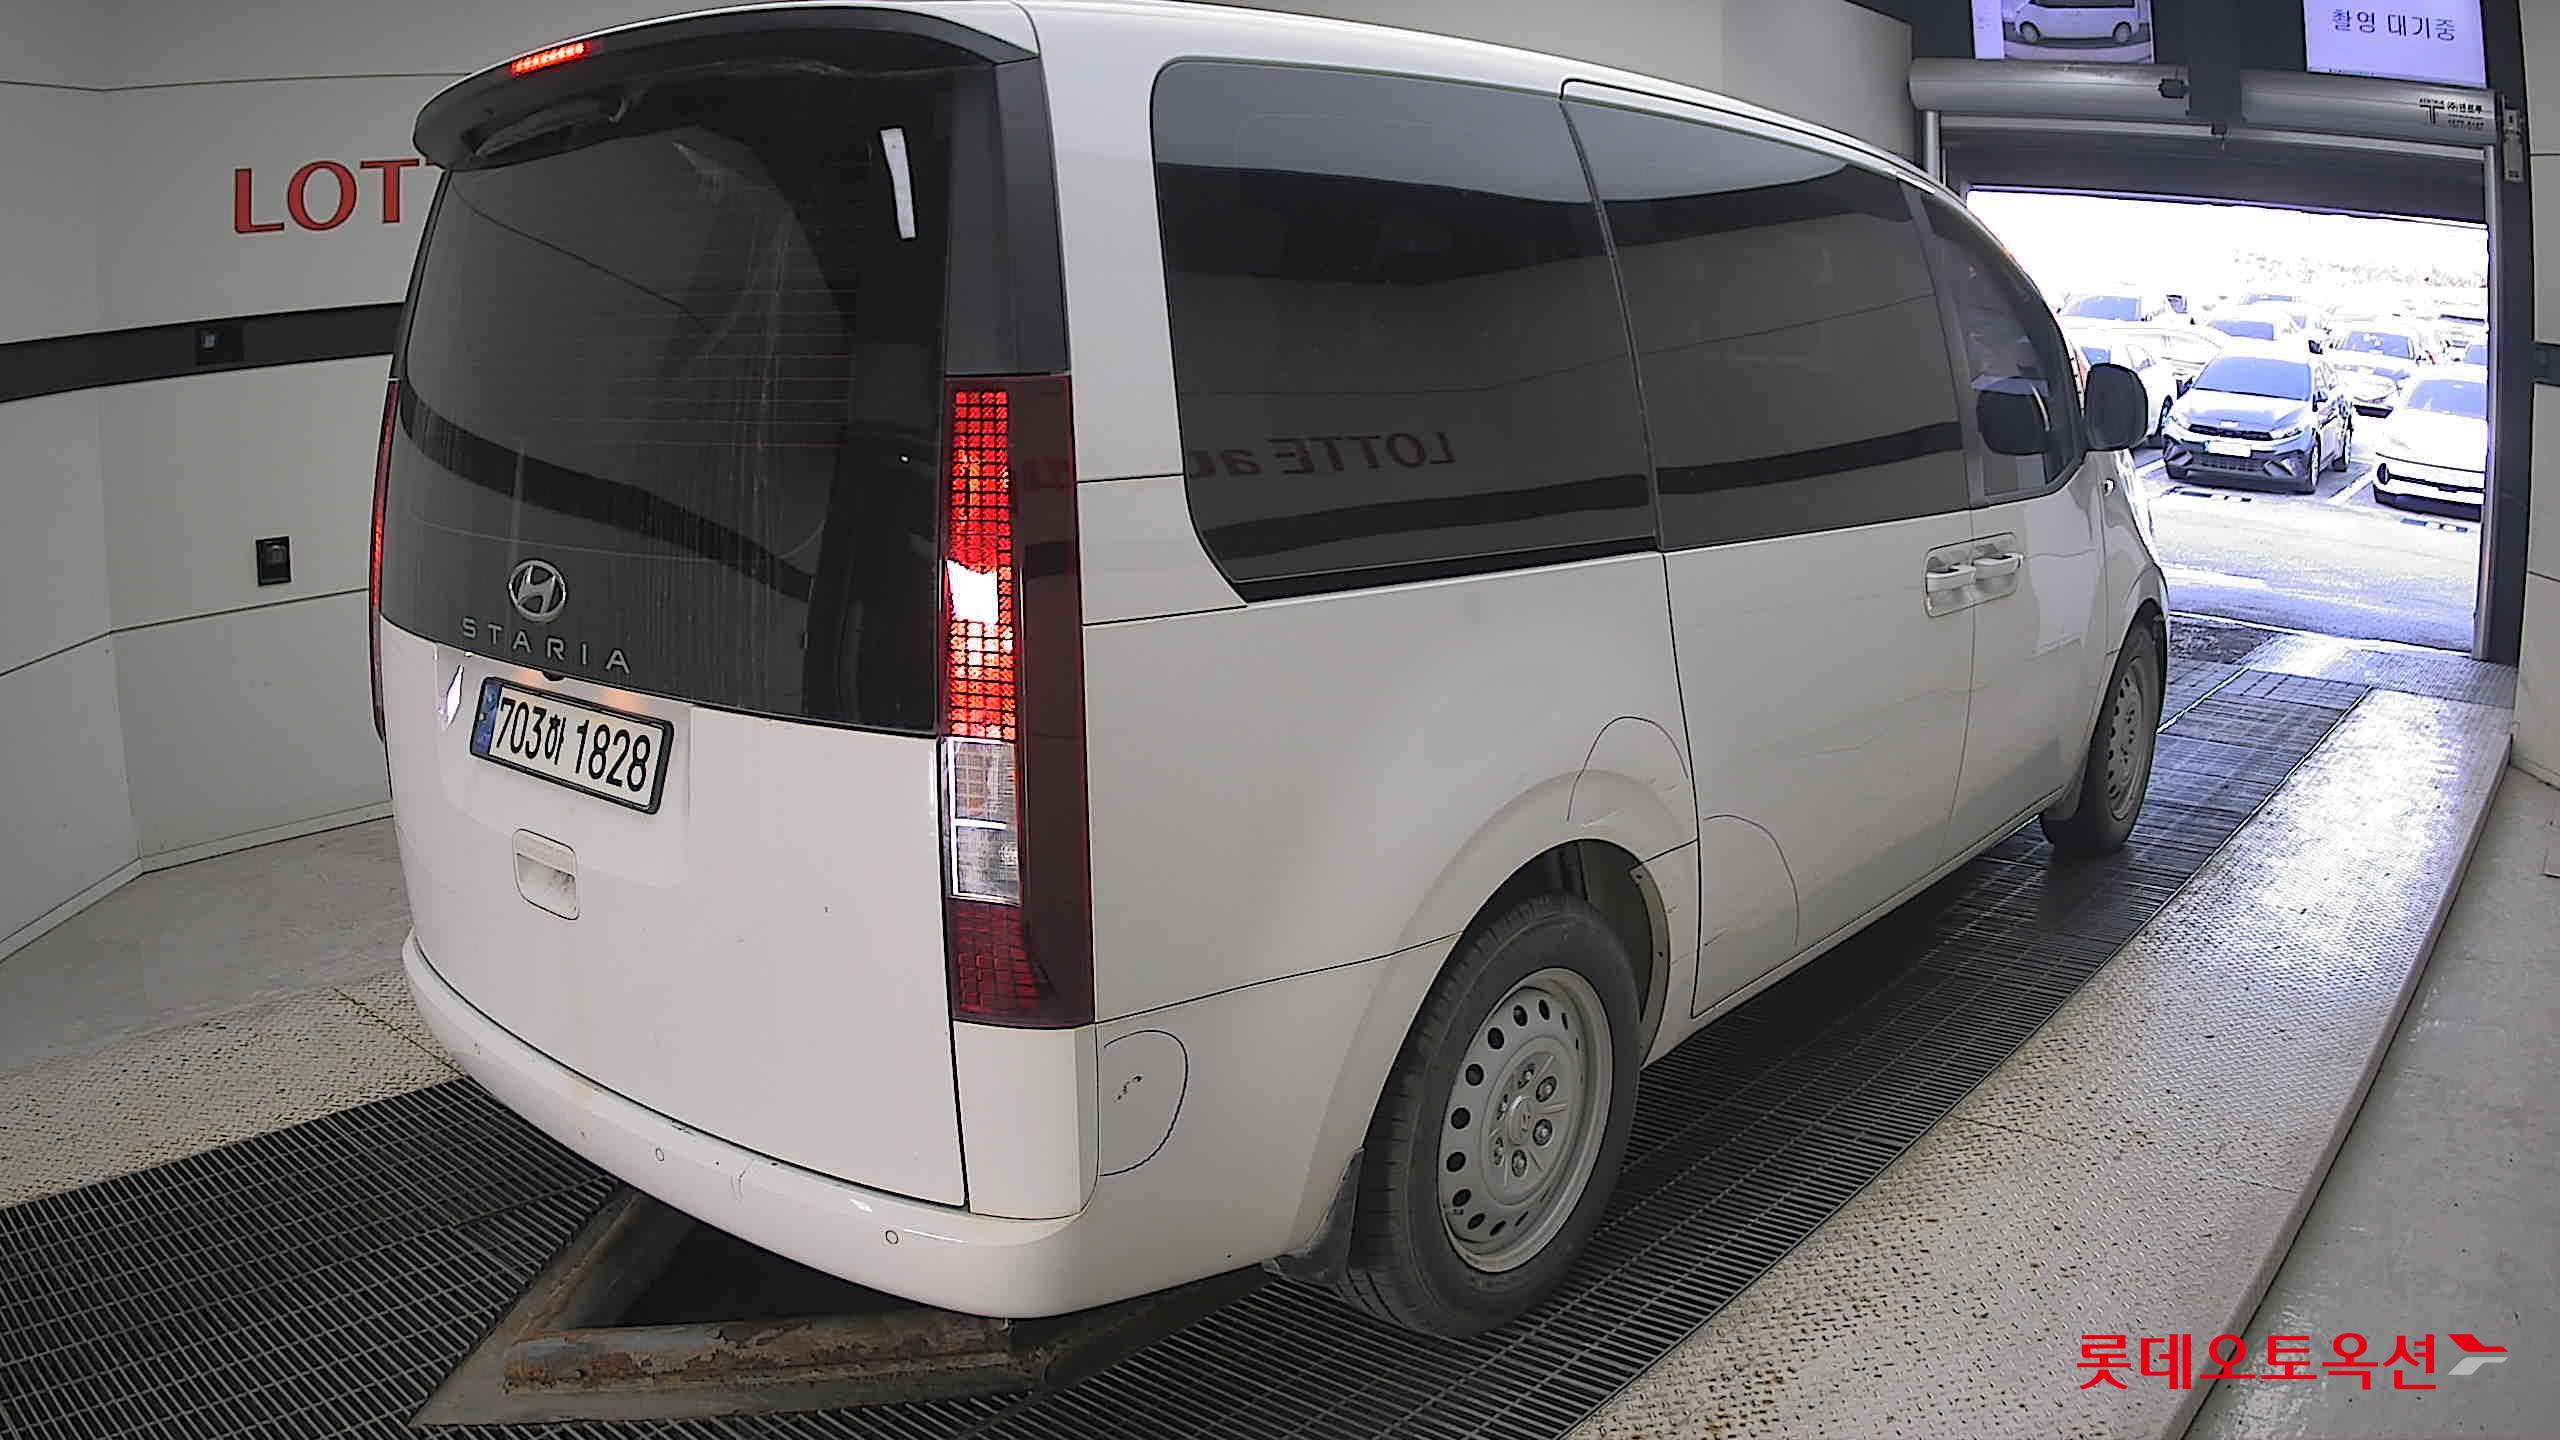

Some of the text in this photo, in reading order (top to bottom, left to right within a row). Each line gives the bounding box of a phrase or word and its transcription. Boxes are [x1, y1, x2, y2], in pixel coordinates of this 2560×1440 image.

[2387, 13, 2456, 42] 대기중
[234, 158, 440, 234] LOT
[461, 616, 631, 674] STARIA
[496, 696, 651, 793] 703하 1828
